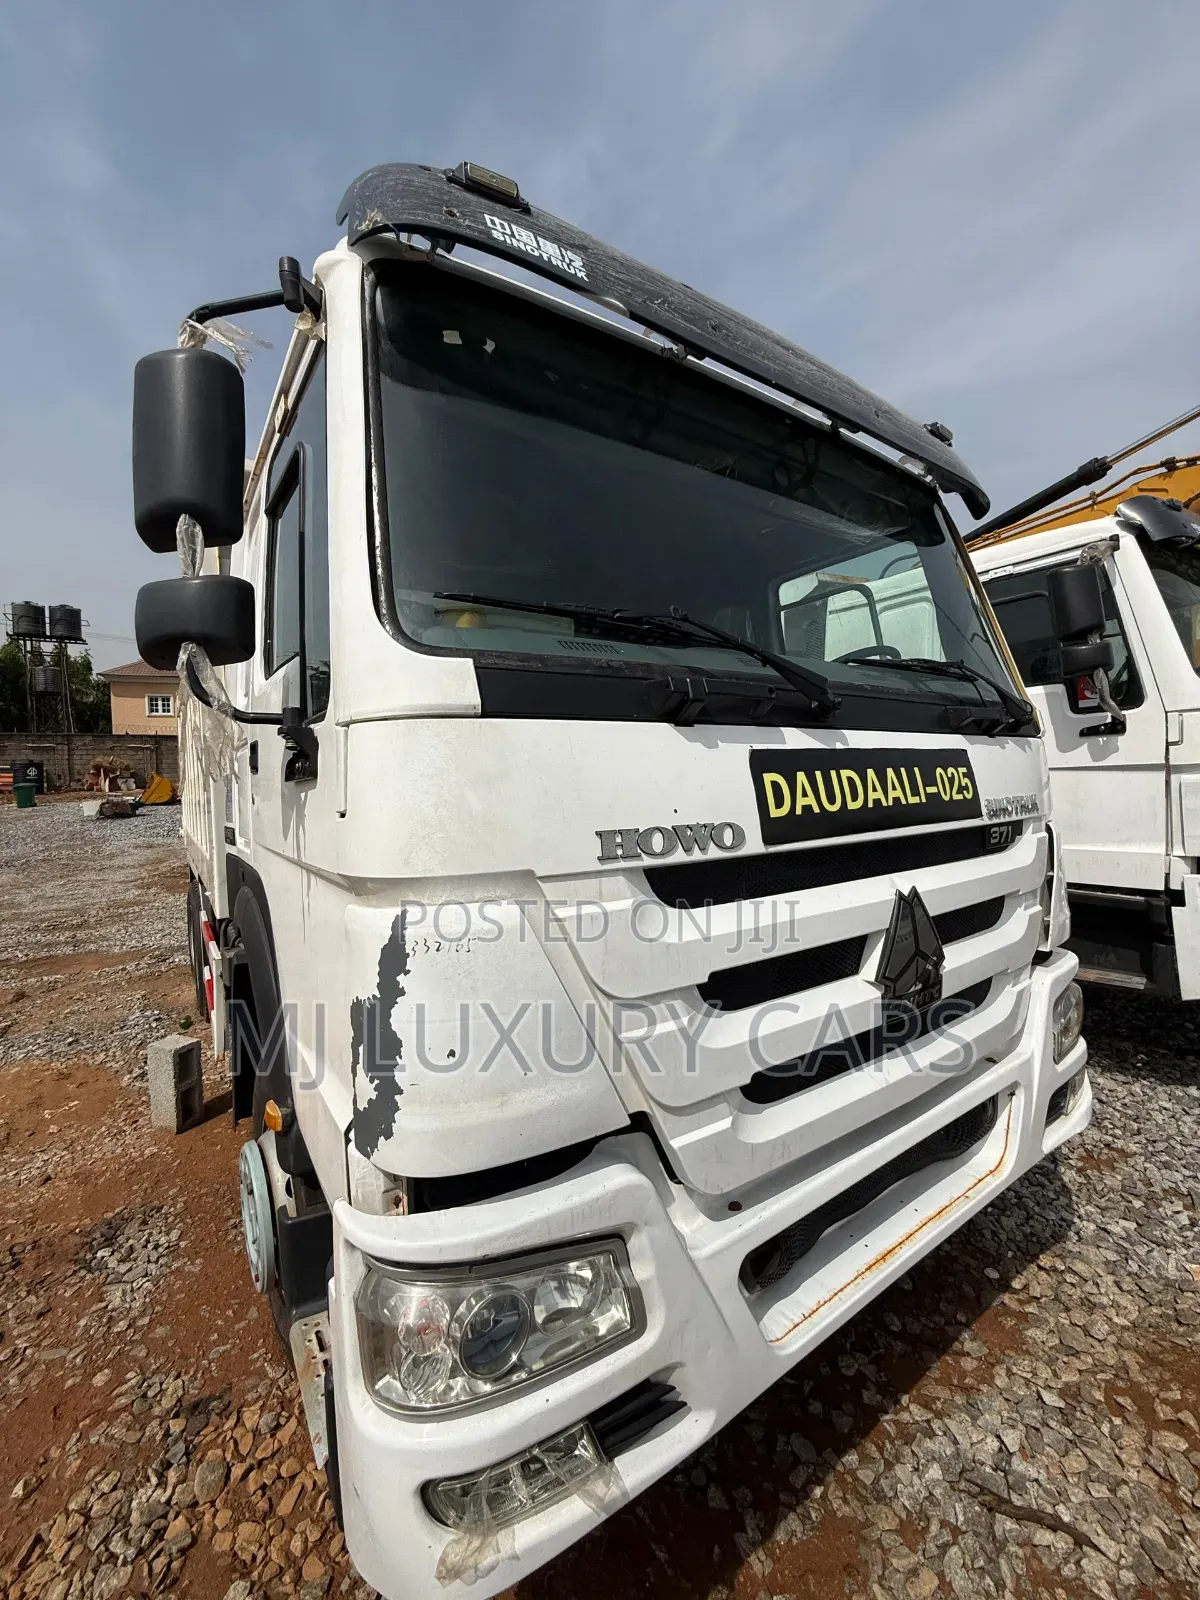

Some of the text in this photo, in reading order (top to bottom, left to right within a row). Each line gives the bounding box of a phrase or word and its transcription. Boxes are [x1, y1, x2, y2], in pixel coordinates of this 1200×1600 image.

[491, 230, 589, 282] SINOTRUK
[762, 766, 974, 818] DAUDAALI-025
[595, 821, 746, 860] HOWO
[990, 826, 1012, 844] 371
